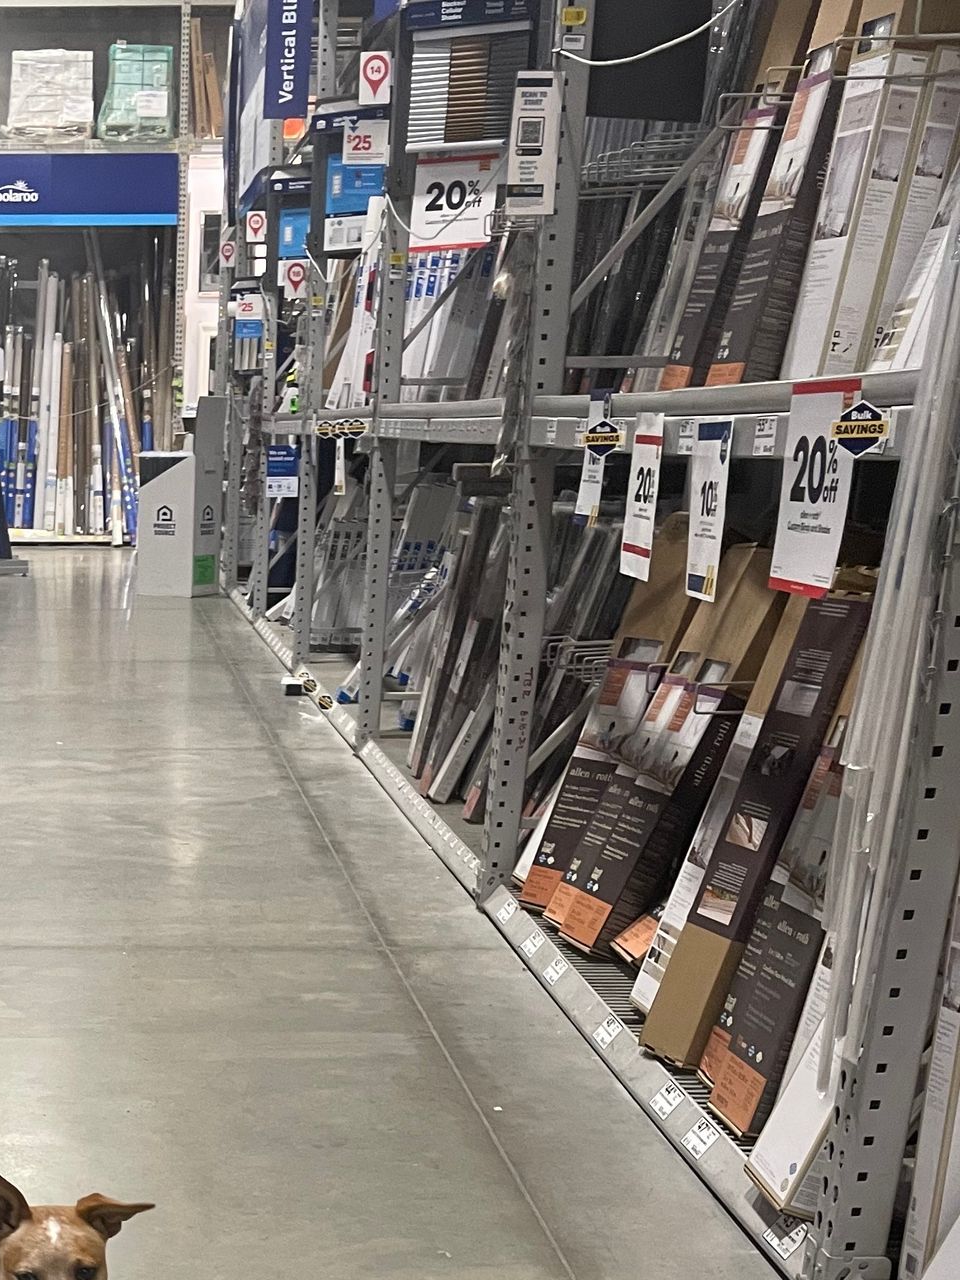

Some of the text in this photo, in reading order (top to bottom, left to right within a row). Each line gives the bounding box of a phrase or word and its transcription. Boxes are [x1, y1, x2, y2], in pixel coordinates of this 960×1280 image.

[278, 30, 297, 104] Vertical
[370, 66, 381, 75] 14
[346, 134, 372, 152] $25
[851, 409, 873, 420] Bulk
[835, 422, 886, 436] SAVINGS
[585, 434, 620, 443] SAVINGS
[822, 477, 839, 504] off
[693, 720, 732, 787] allen roth
[569, 766, 615, 784] allen roth
